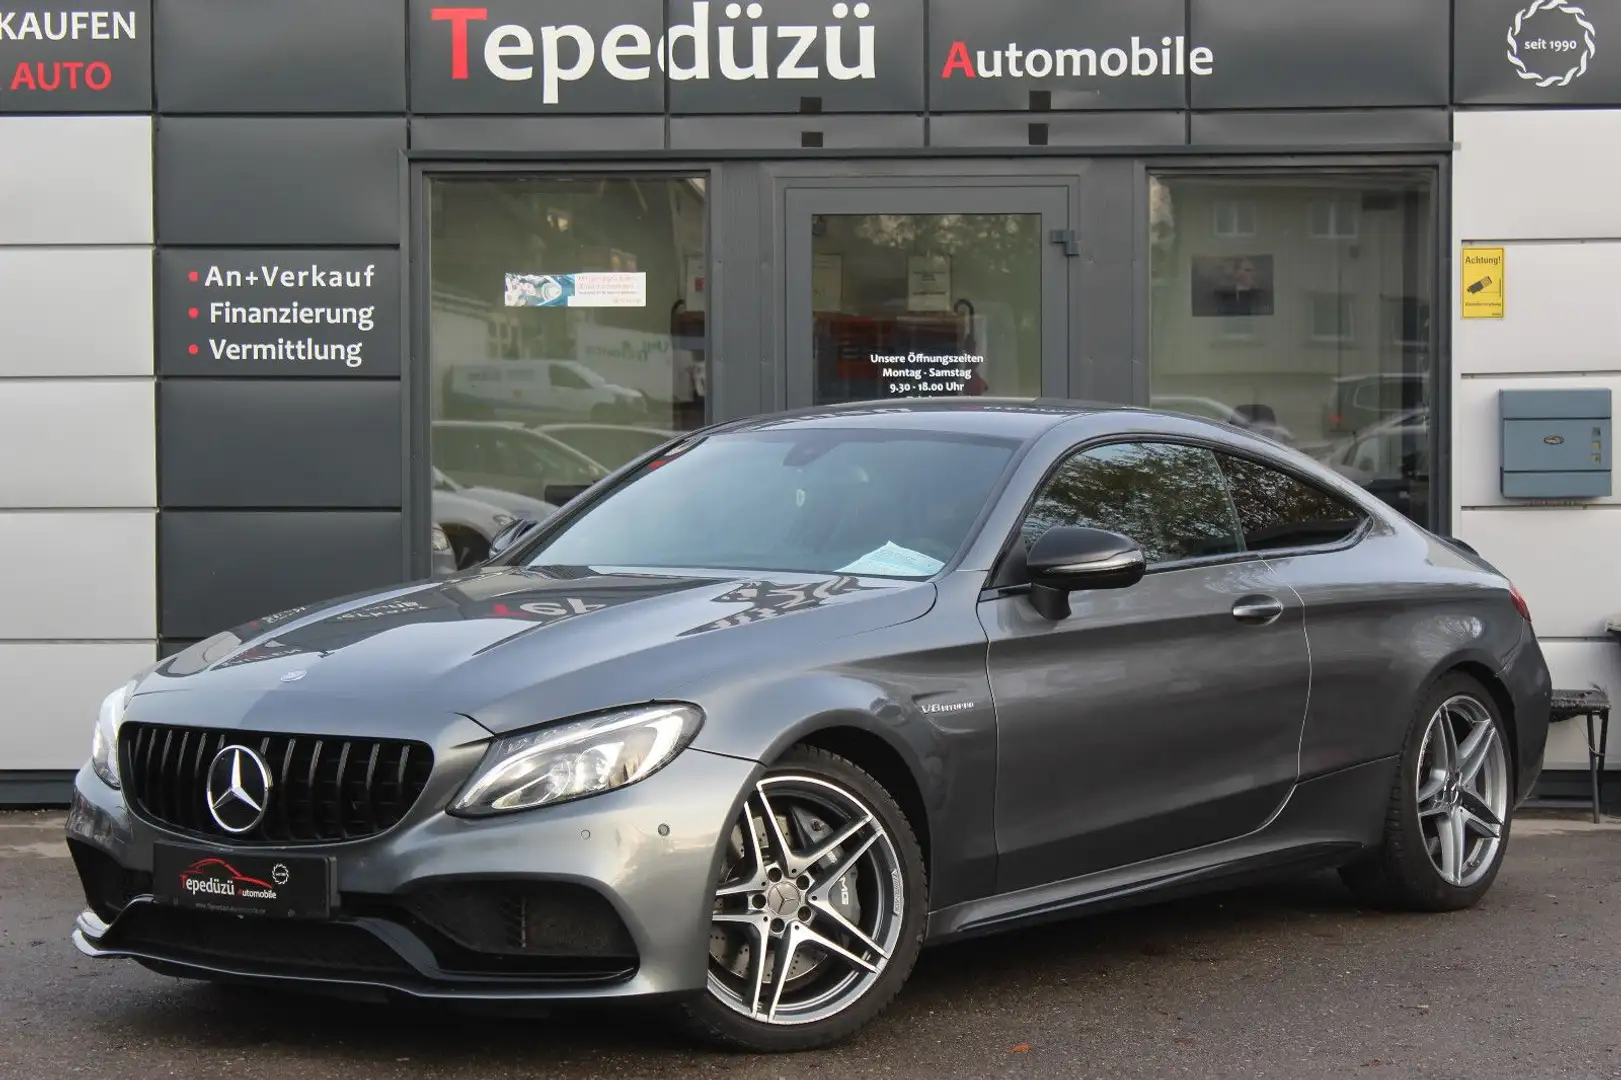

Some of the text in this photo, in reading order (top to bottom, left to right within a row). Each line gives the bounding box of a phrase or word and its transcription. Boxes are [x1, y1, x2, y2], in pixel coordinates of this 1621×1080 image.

[0, 12, 136, 40] KAUFEN
[431, 2, 876, 104] Tepedüzü
[941, 36, 1213, 78] Automobile
[1524, 38, 1577, 52] seit 1990
[10, 62, 112, 91] AUTO
[1465, 255, 1501, 266] Achtung!
[204, 264, 375, 288] An+Verkauf
[209, 301, 375, 331] Finanzierung
[208, 338, 363, 367] Vermittlung
[870, 352, 984, 366] Unsere Öffnungszeiten
[882, 368, 922, 380] Montag
[928, 368, 972, 380] Samstag
[889, 383, 911, 394] 9.30
[918, 381, 944, 392] 18.00
[945, 381, 965, 392] Uhr
[181, 873, 235, 896] Tepedüzü
